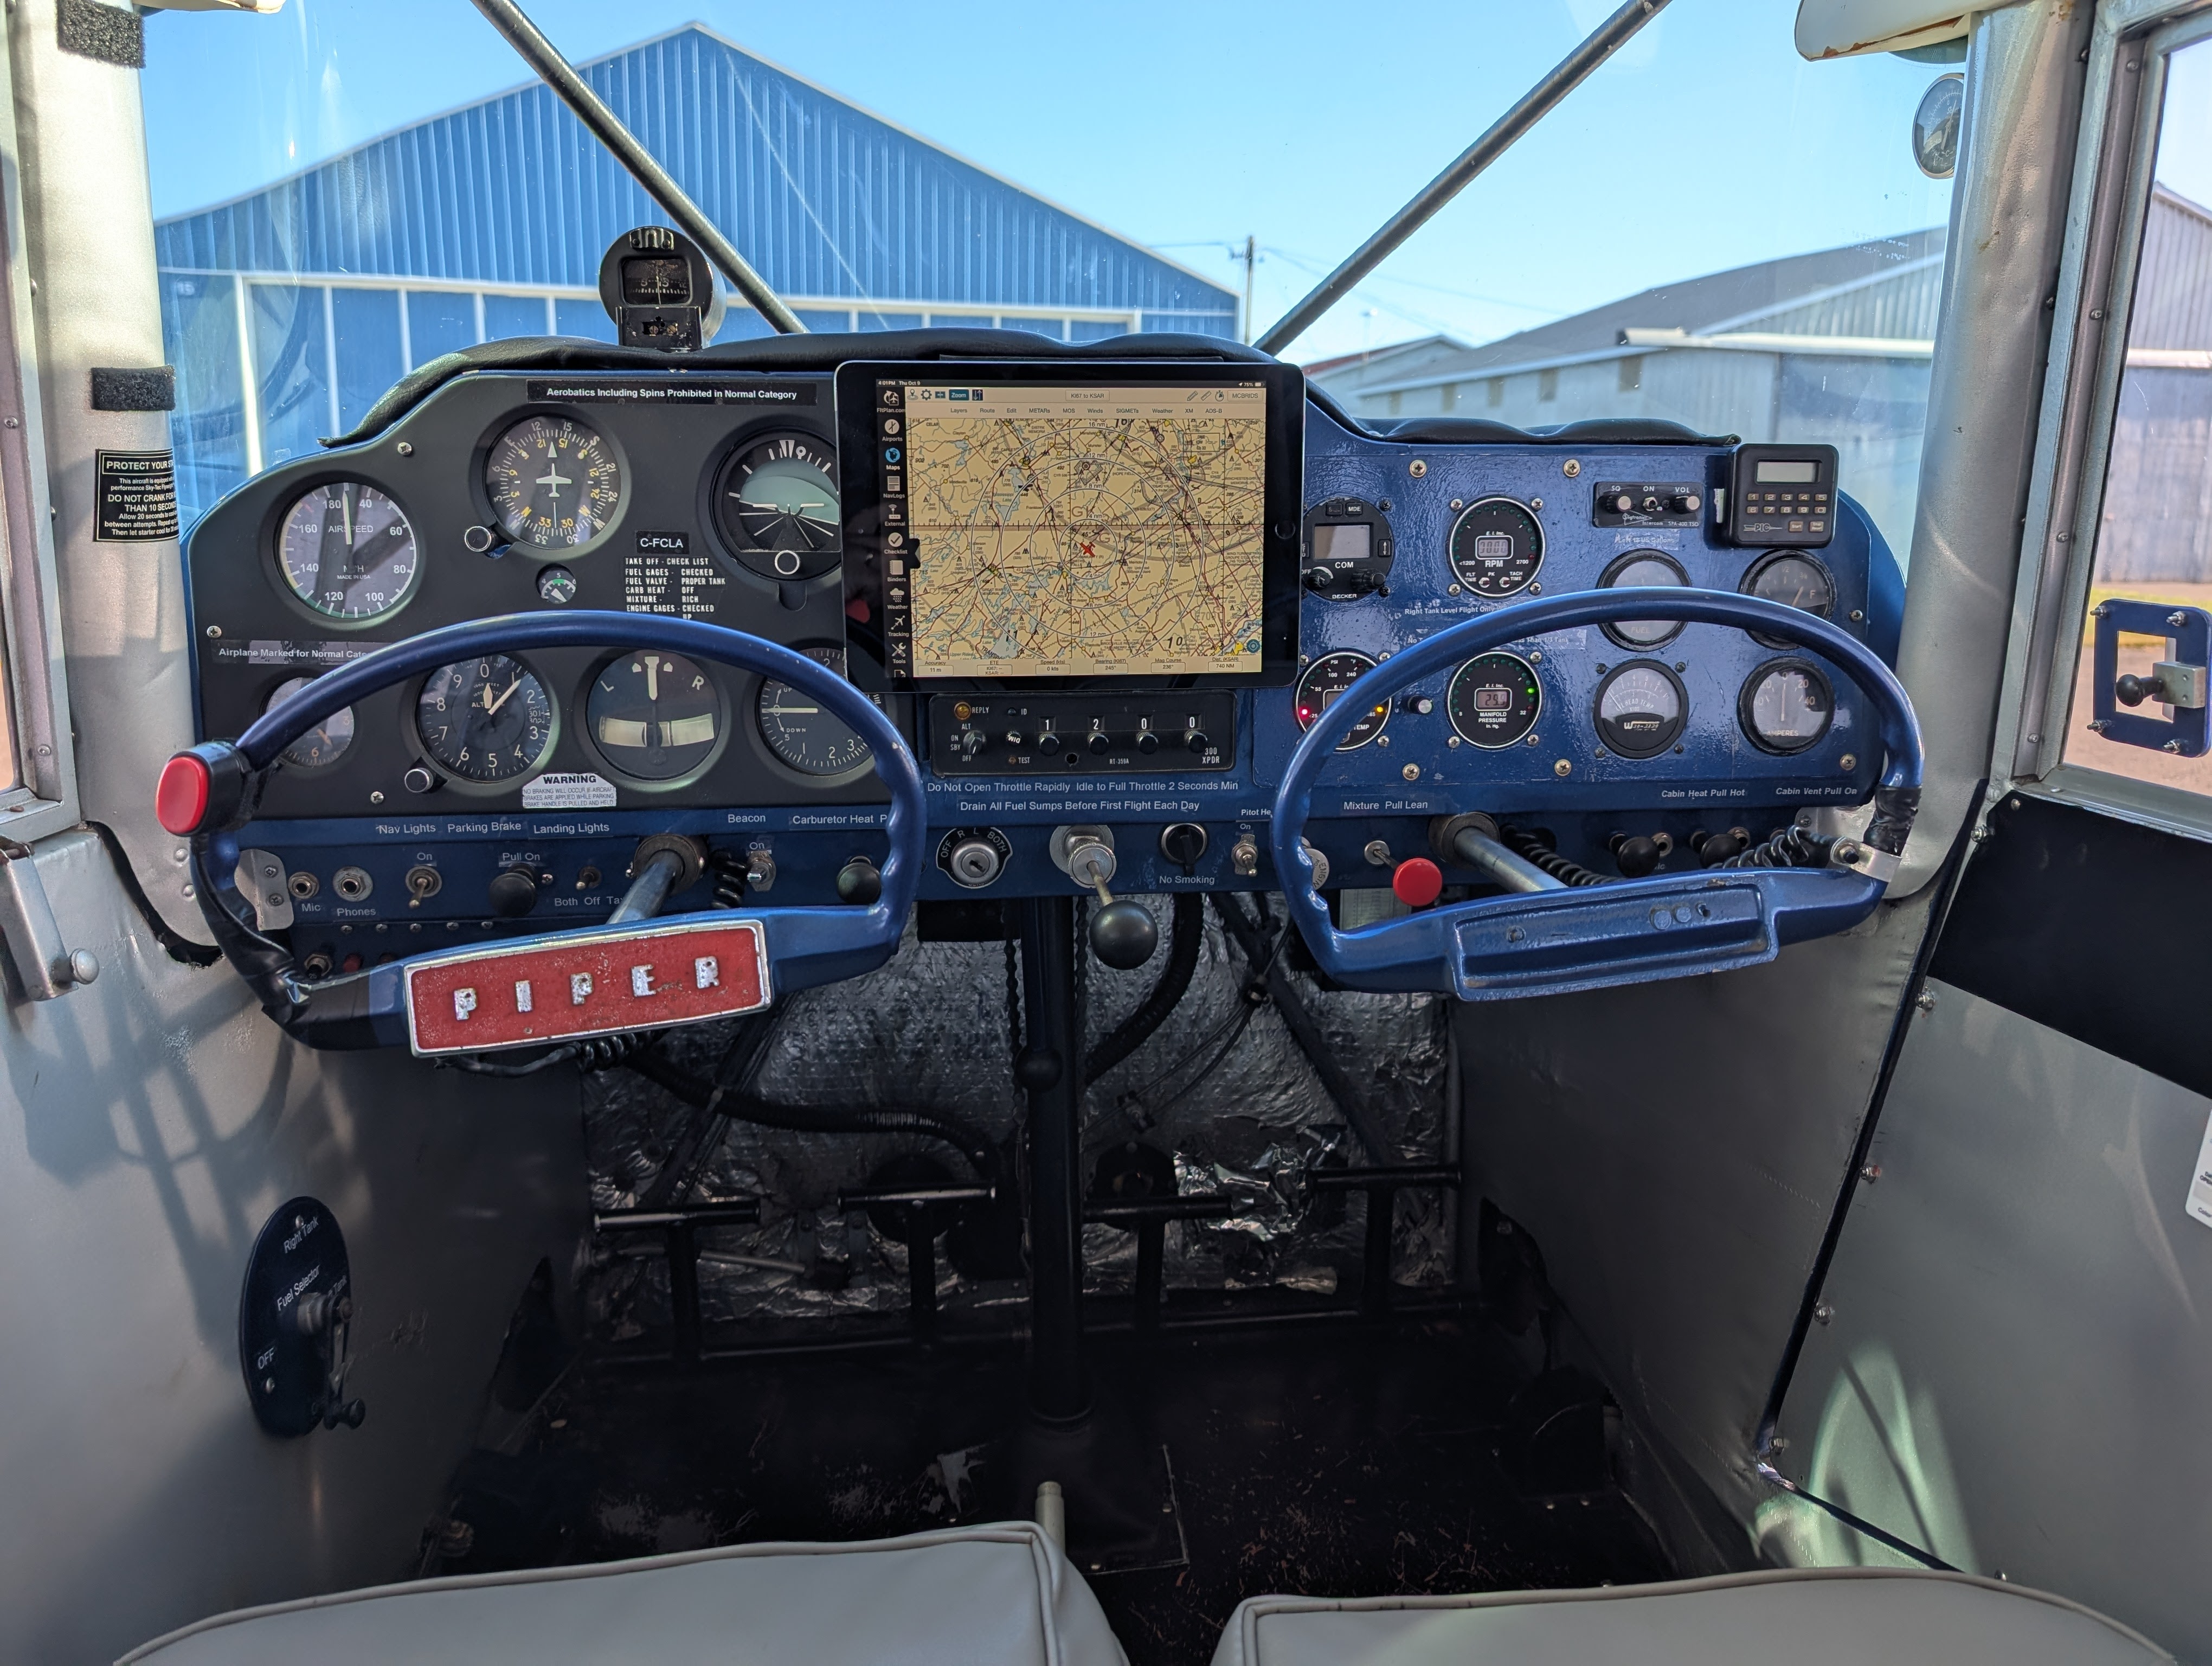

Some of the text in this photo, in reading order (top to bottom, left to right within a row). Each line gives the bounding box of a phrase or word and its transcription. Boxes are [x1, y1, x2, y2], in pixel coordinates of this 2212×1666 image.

[546, 388, 595, 396] Aerobatics
[598, 389, 638, 398] Including
[640, 389, 665, 398] Spins
[758, 390, 796, 400] Category
[532, 422, 541, 431] 12
[563, 422, 572, 431] 15
[107, 461, 150, 470] PROTECT
[152, 461, 168, 469] YOUR
[323, 499, 341, 509] 180
[359, 499, 372, 508] 40
[299, 524, 317, 533] 160
[390, 527, 402, 536] 60
[640, 538, 683, 548] C-FCLA
[300, 563, 319, 572] 140
[394, 565, 406, 574] 80
[325, 592, 343, 600] 120
[219, 649, 258, 657] Airplane
[527, 690, 535, 703] 2
[437, 697, 446, 711] 8
[1045, 717, 1195, 731] 1 2 0 0
[489, 754, 497, 767] 5
[543, 776, 596, 784] WARNING
[928, 783, 941, 791] Do
[944, 783, 961, 791] Not
[965, 783, 991, 793] Open
[994, 783, 1031, 791] Throttle
[1035, 783, 1070, 793] Rapidly
[1076, 783, 1093, 791] Idle
[1129, 782, 1166, 790] Throttle
[1178, 781, 1218, 790] Seconds
[1221, 781, 1238, 790] Min
[961, 802, 986, 811] Drain
[989, 802, 1001, 810] All
[1005, 802, 1026, 810] Fuel
[1029, 802, 1062, 811] Sumps
[1065, 801, 1097, 810] Before
[1124, 801, 1150, 811] Flight
[1154, 801, 1178, 809] Each
[1181, 801, 1199, 811] Day
[1344, 802, 1379, 810] Mixture
[728, 814, 766, 823] Beacon
[793, 815, 873, 824] Carburetor Heat
[379, 824, 436, 834] Nav Lights
[448, 822, 521, 832] Parking Brake
[533, 824, 609, 834] Landing Lights
[1175, 875, 1214, 885] Smoking
[454, 956, 720, 1020] PIPER
[284, 1216, 319, 1253] Right Tank
[277, 1265, 320, 1311] Fuel Selector
[258, 1347, 275, 1369] OFF
